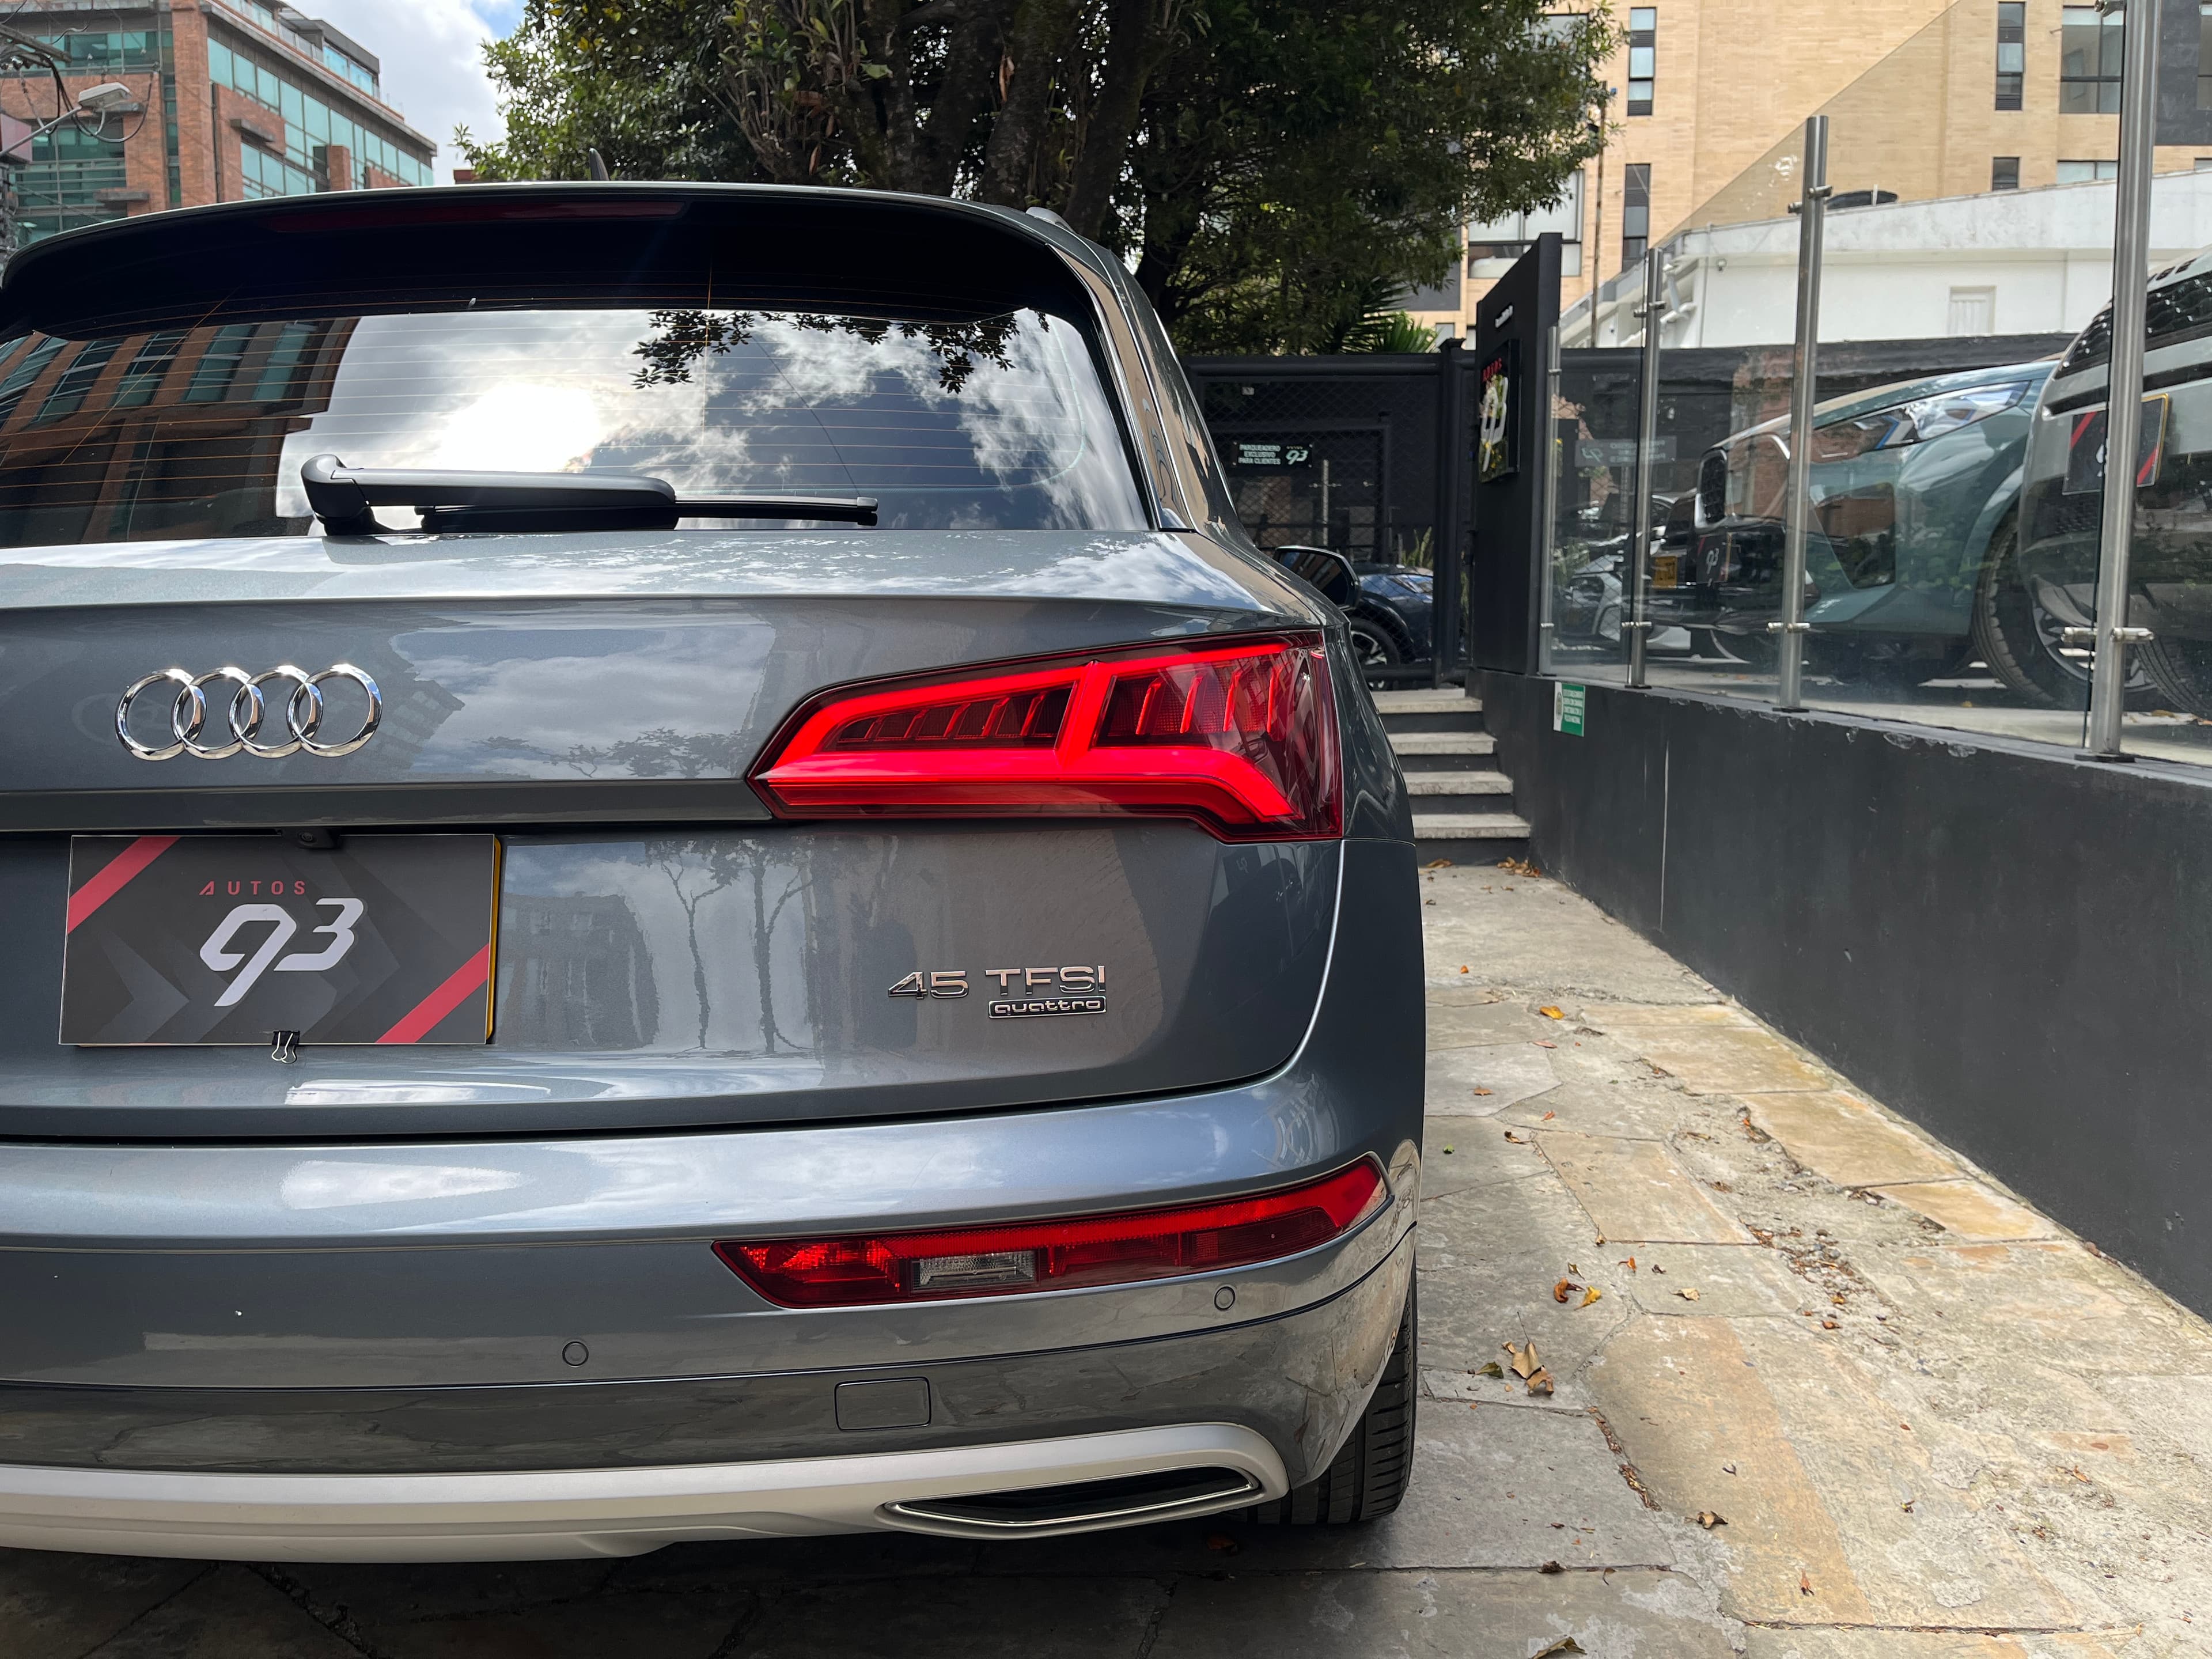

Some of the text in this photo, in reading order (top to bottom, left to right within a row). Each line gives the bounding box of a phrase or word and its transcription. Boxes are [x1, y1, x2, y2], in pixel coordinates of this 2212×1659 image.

[1285, 450, 1308, 465] 93
[199, 880, 305, 895] AUTOS
[199, 897, 364, 1007] 93
[888, 965, 1106, 999] 45 TFSI
[994, 999, 1101, 1016] quattro
